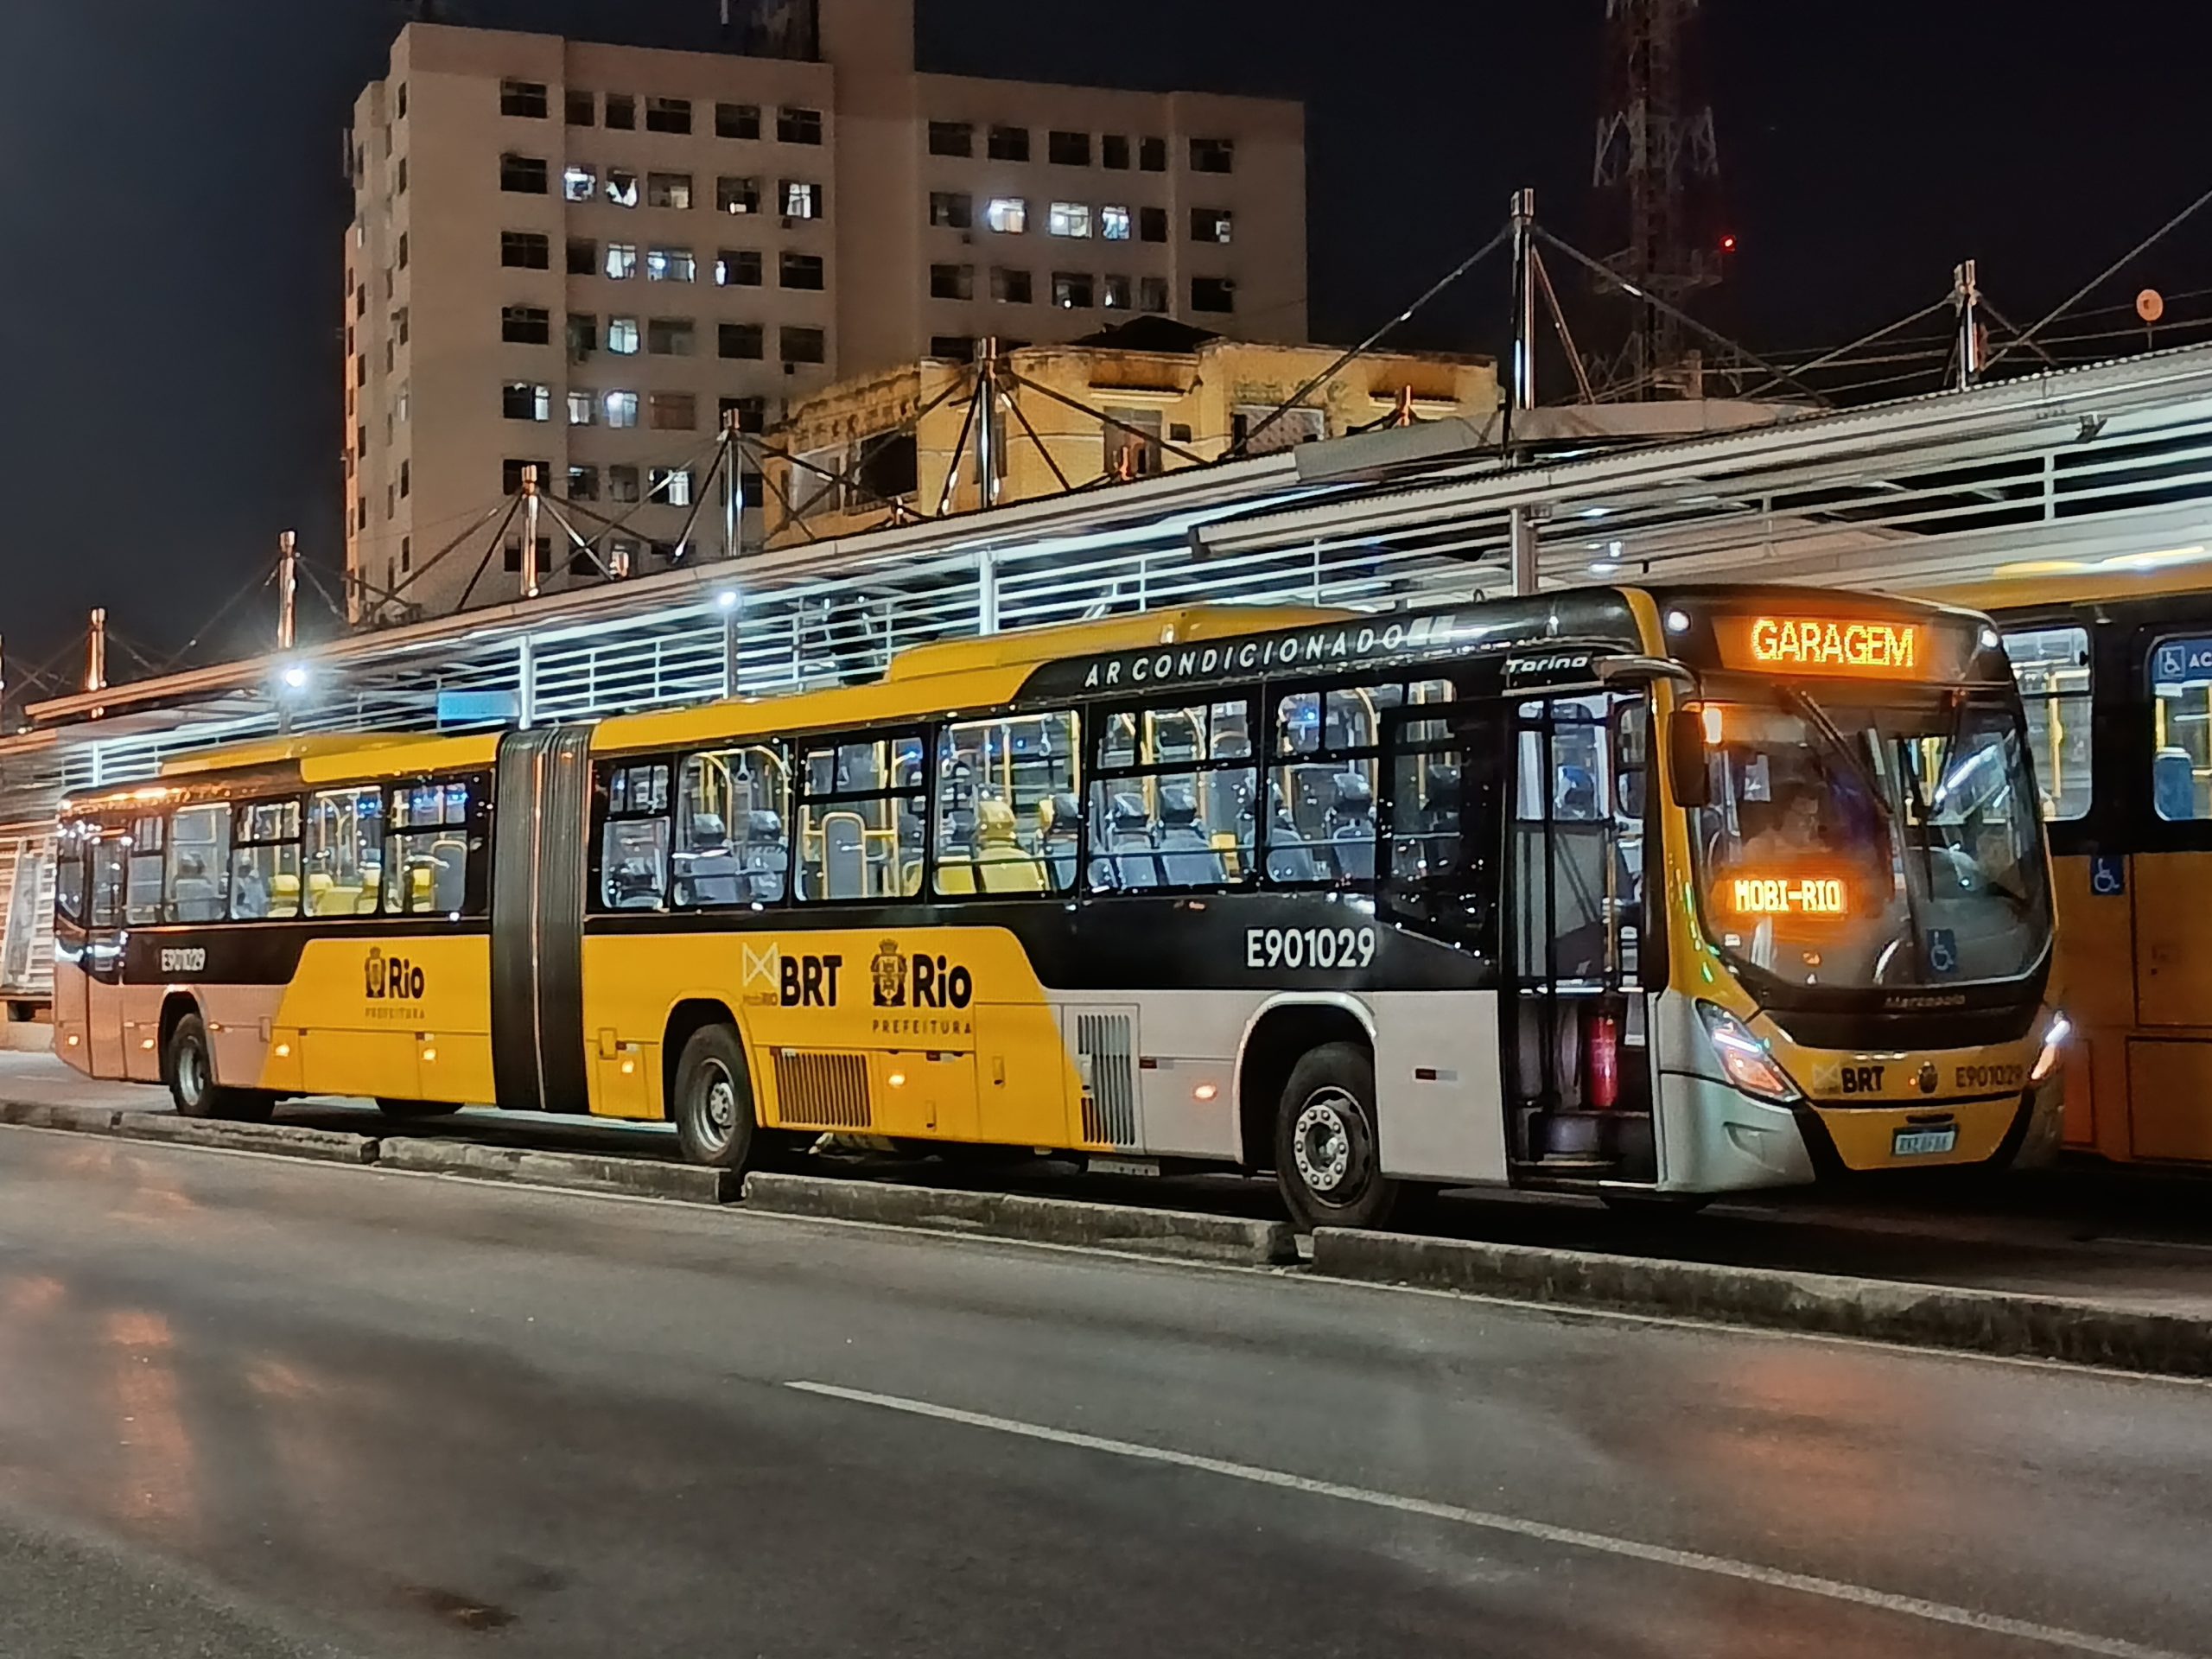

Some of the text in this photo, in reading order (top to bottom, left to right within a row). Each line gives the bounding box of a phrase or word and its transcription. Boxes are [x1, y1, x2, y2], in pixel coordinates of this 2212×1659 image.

[1084, 624, 1403, 687] AR CONDICIONADO
[1506, 655, 1588, 673] Torino
[1751, 619, 1914, 668] GARAGEM
[1734, 879, 1841, 912] MOBI-RIO
[1247, 927, 1376, 968] E901029
[389, 957, 425, 1000] Rio
[779, 954, 842, 1007] BRT
[912, 953, 973, 1008] Rio
[873, 1019, 972, 1034] PREFEITURA
[1840, 1065, 1885, 1094] BRT
